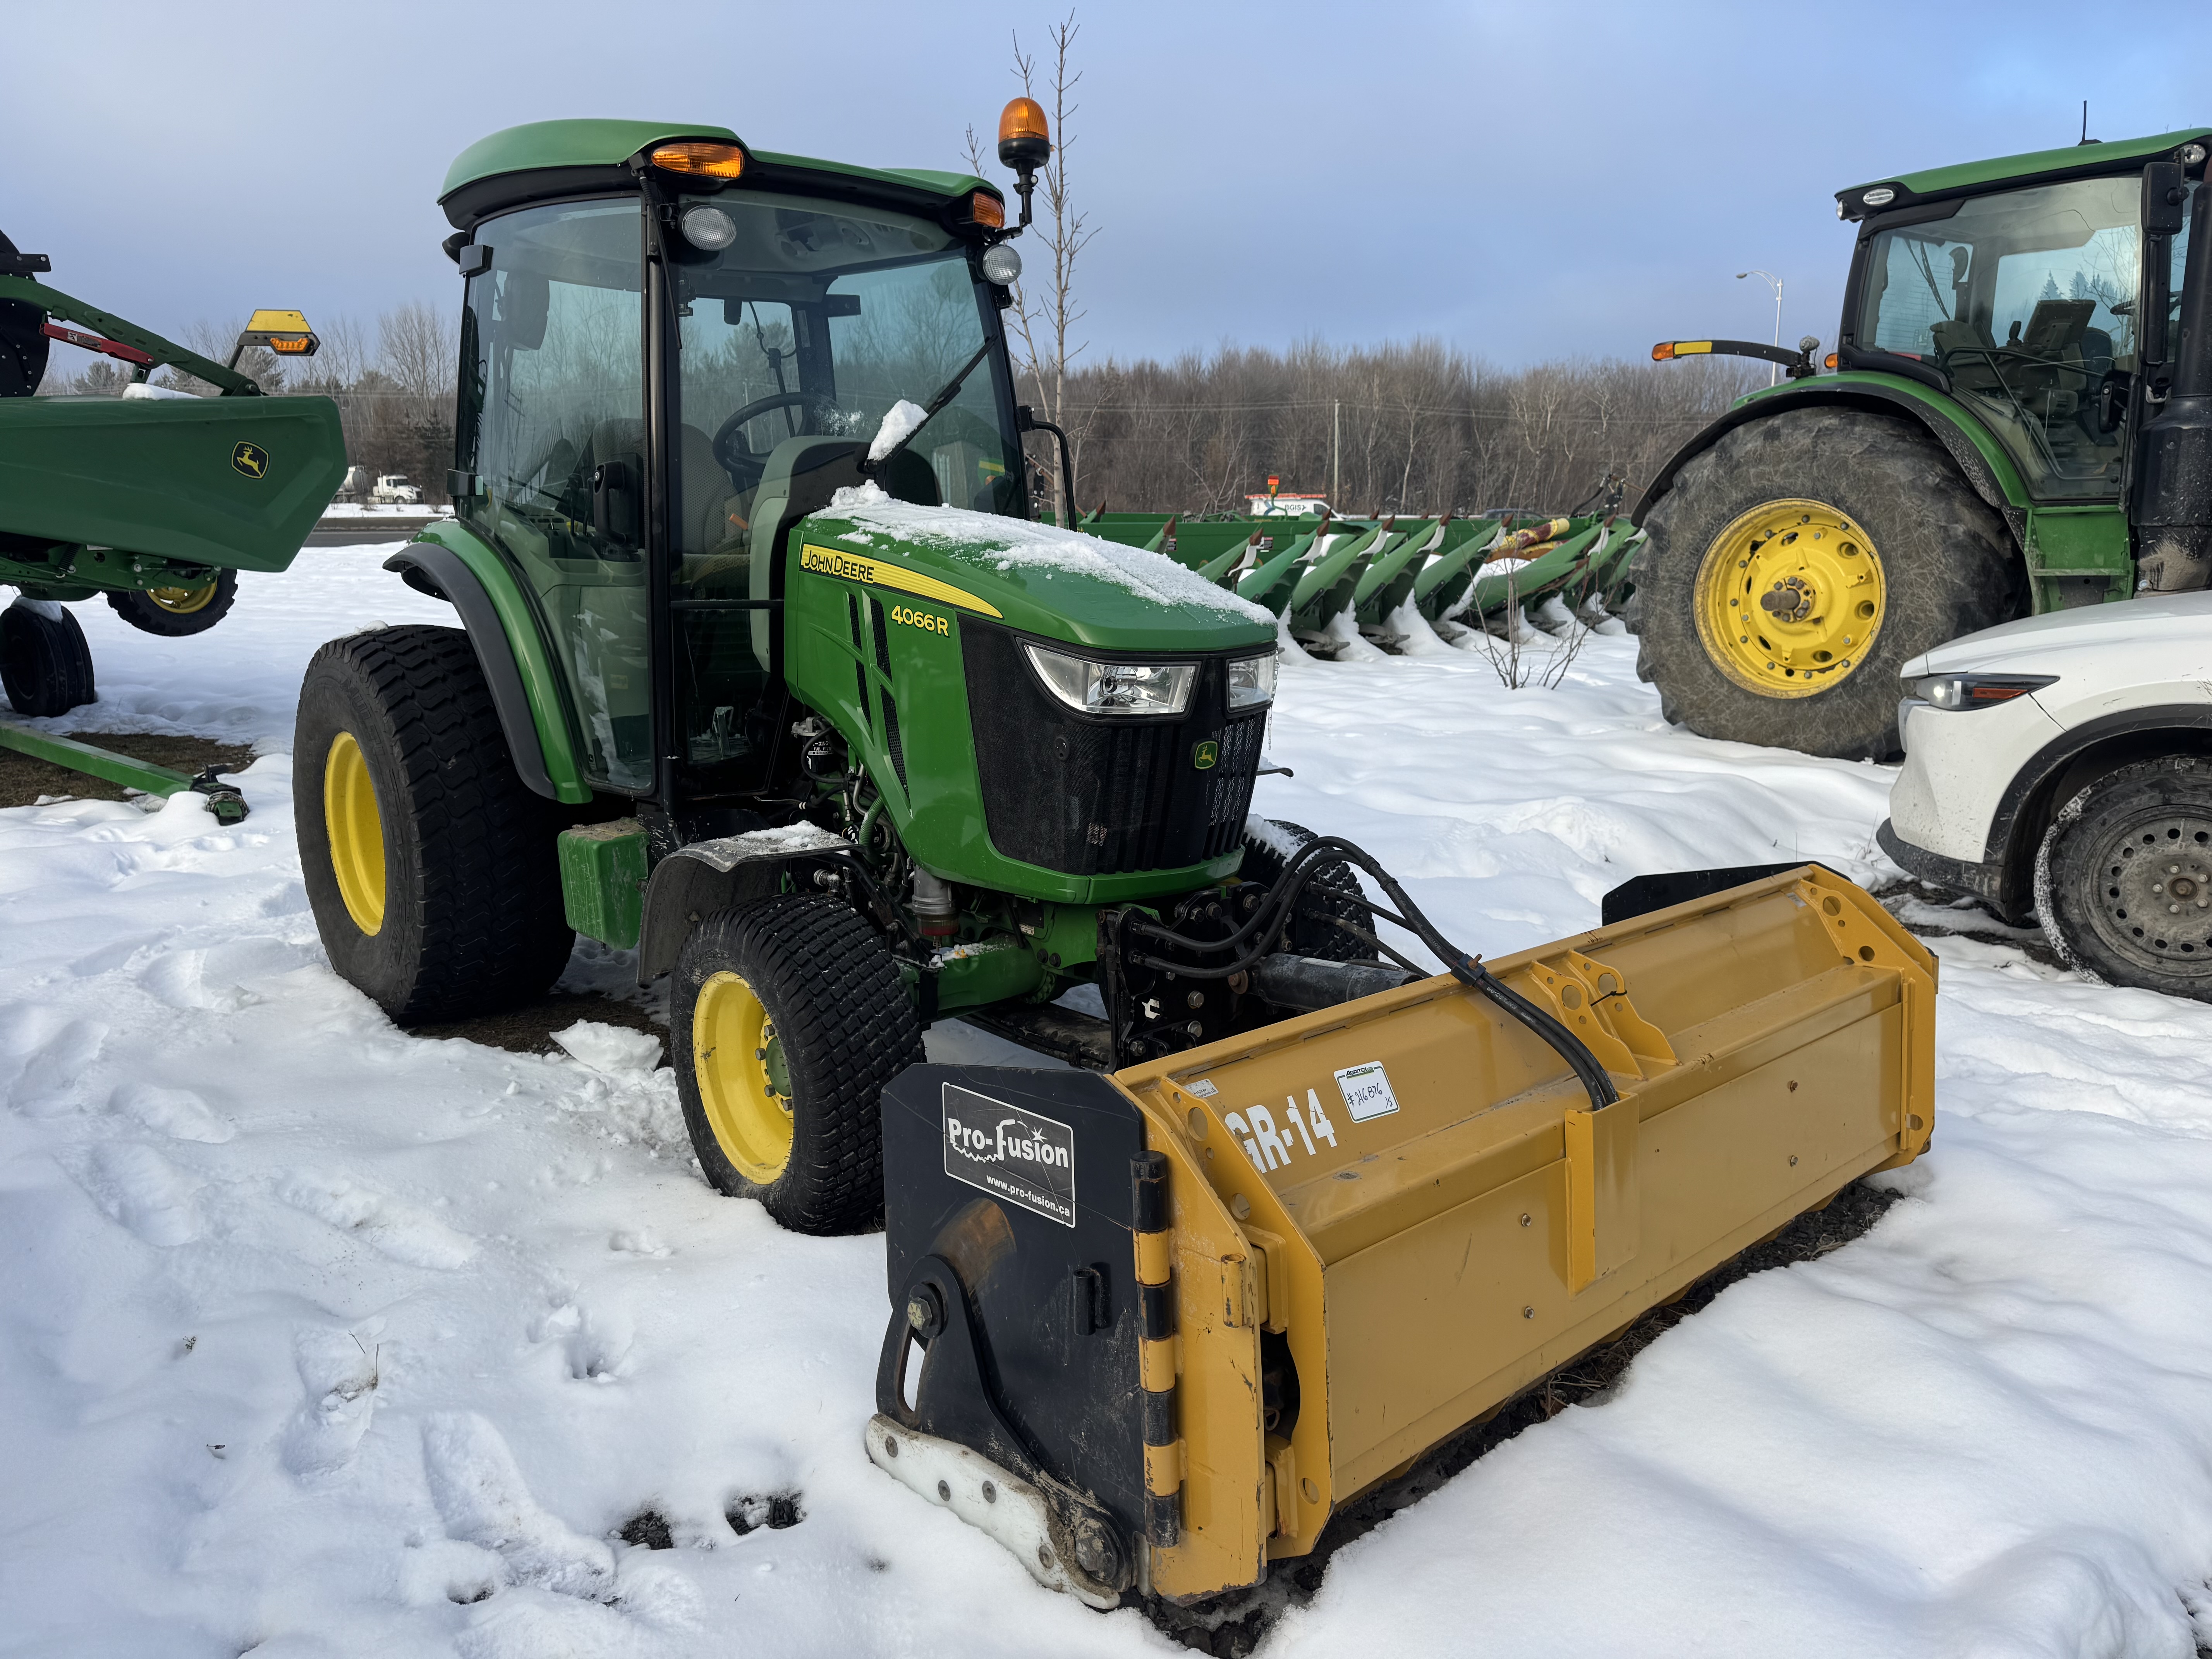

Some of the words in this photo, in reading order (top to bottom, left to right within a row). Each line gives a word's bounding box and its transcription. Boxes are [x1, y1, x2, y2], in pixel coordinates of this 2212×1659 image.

[805, 550, 833, 572] JOHN
[835, 555, 874, 582] DEERE
[891, 605, 949, 637] 4066R
[1346, 1066, 1368, 1076] AGRITEX
[948, 1118, 1069, 1168] Pro-fusion
[986, 1175, 1070, 1217] www.pro-fusion.ca
